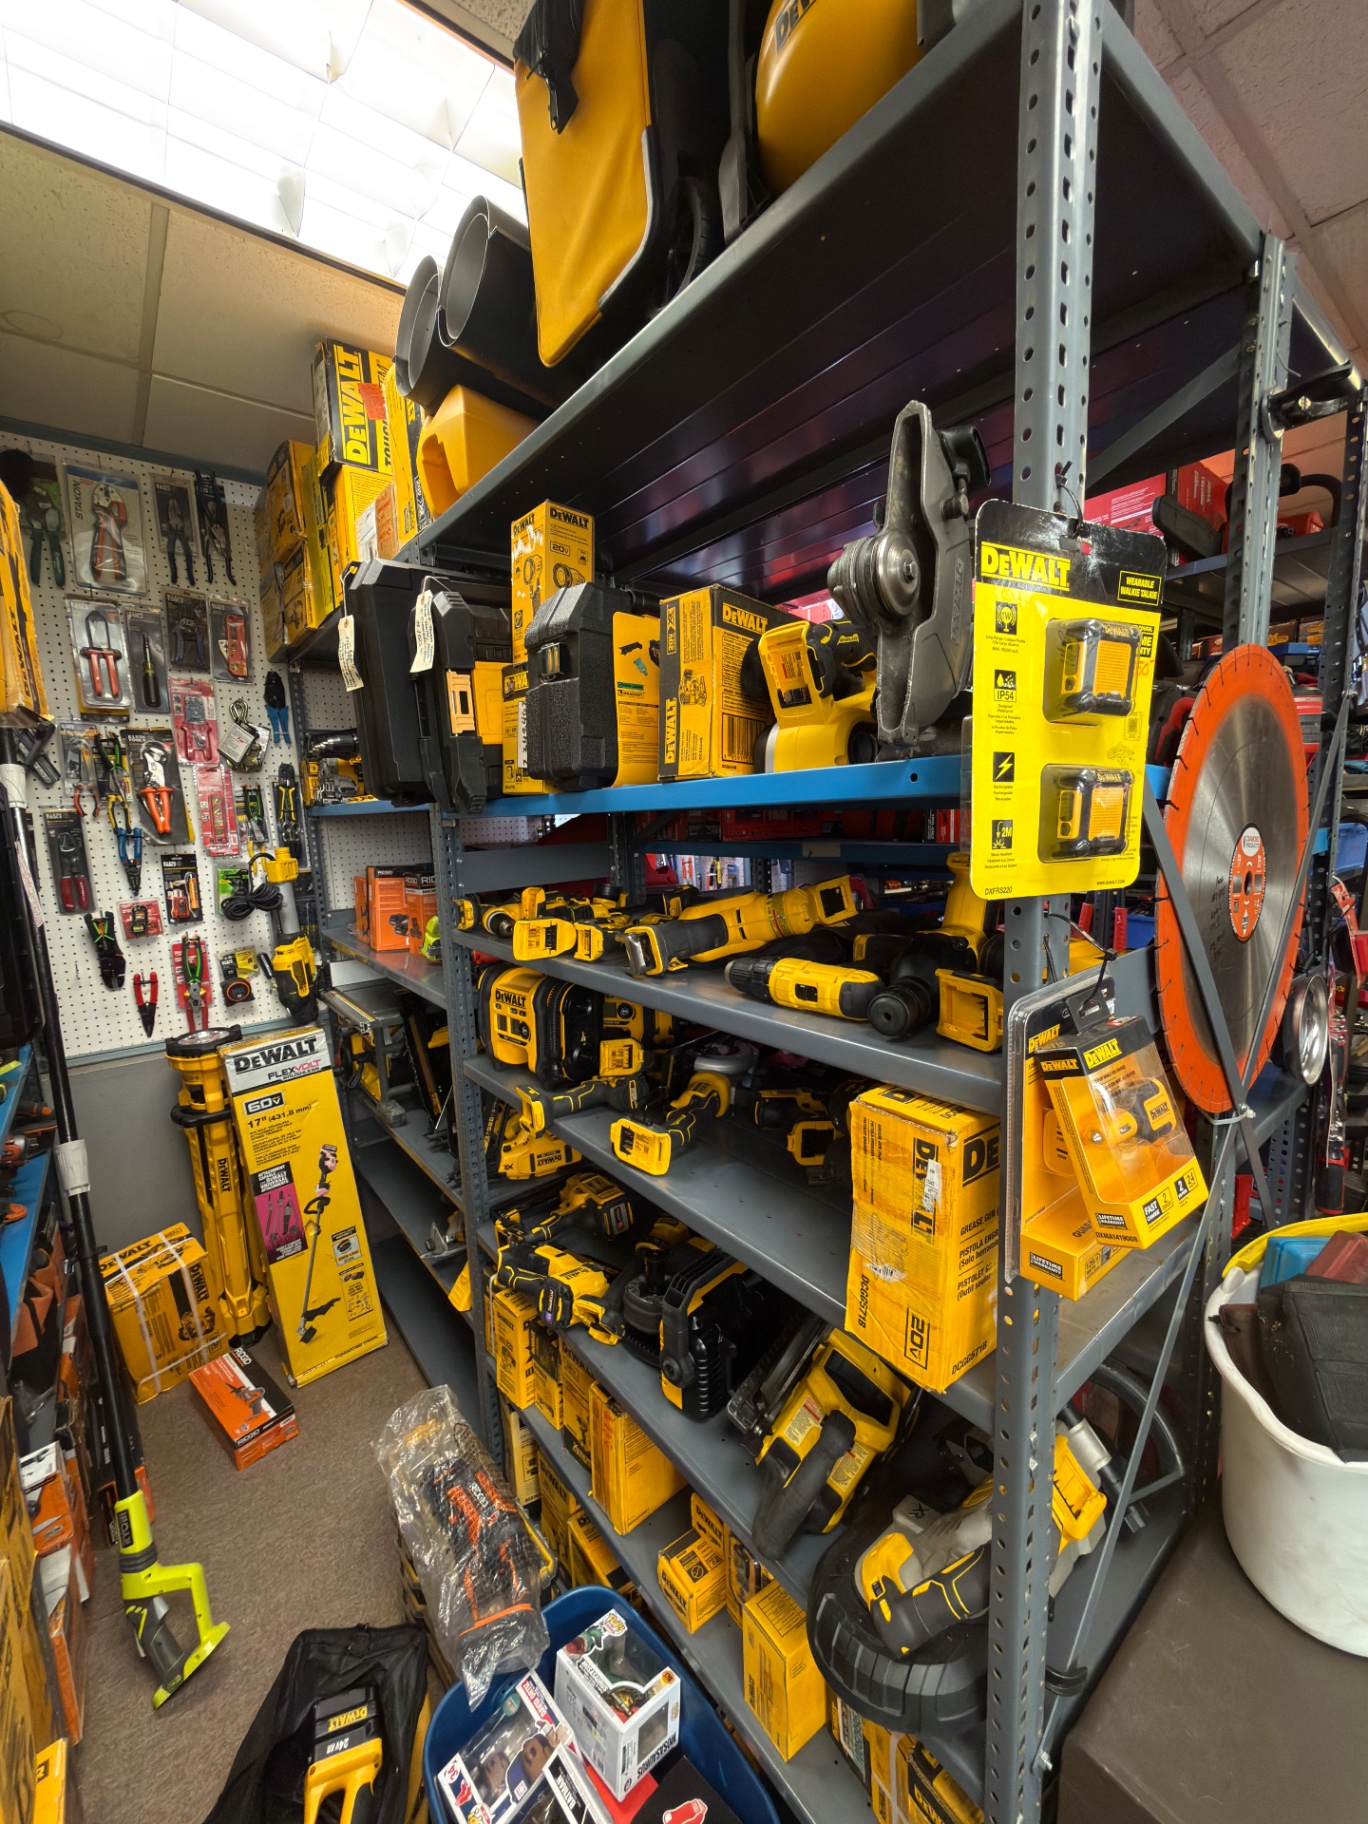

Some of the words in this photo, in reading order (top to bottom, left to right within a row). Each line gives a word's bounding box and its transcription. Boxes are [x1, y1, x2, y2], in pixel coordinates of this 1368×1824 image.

[337, 345, 367, 464] DEWALT
[73, 480, 83, 520] STAKON
[550, 507, 589, 529] DEWALT
[981, 547, 1070, 588] DEWALT
[1121, 586, 1140, 597] WALKIE
[1141, 589, 1158, 600] TALKIE
[1126, 576, 1155, 589] WEARABLE
[723, 606, 768, 633] DEWALT
[997, 689, 1014, 701] IP54
[664, 697, 678, 764] DEWALT
[1001, 827, 1012, 838] 2M
[985, 886, 1013, 895] DXFRS220
[496, 990, 526, 1008] DEWALT
[1029, 1026, 1060, 1053] DEWALT
[234, 1038, 317, 1073] DEWALT
[1084, 1040, 1121, 1067] DEWALT
[268, 1059, 321, 1080] FLEXVOLT
[1041, 1060, 1078, 1071] DEWALT
[247, 1115, 267, 1129] 17"
[268, 1109, 294, 1123] (431.8
[296, 1103, 312, 1115] mm)
[1151, 1102, 1169, 1120] DEWALT
[218, 1158, 231, 1192] DEWALT
[1178, 1180, 1184, 1191] 2
[1144, 1200, 1157, 1216] FAST
[1162, 1193, 1167, 1203] 2
[960, 1216, 983, 1235] GREASE
[984, 1211, 996, 1223] GUN
[1098, 1214, 1124, 1223] LIFETIME
[959, 1240, 984, 1259] PISTOLA
[958, 1255, 974, 1270] (Solo
[1033, 1253, 1062, 1271] LIFETIME
[190, 1263, 209, 1301] DEWALT
[957, 1269, 984, 1290] PISTOLET
[858, 1274, 870, 1328] DCGG571B
[952, 1340, 988, 1375] DCGG571B
[471, 1482, 489, 1508] RIDGID
[696, 1504, 722, 1538] DEWALT
[662, 1570, 687, 1608] DEWALT
[523, 1682, 535, 1699] ORTIZ
[533, 1697, 546, 1717] DAVID
[328, 1706, 368, 1732] DEWALT
[637, 1732, 676, 1779] MOSASAURUS
[448, 1765, 458, 1780] 34
[557, 1775, 576, 1809] BATMAN
